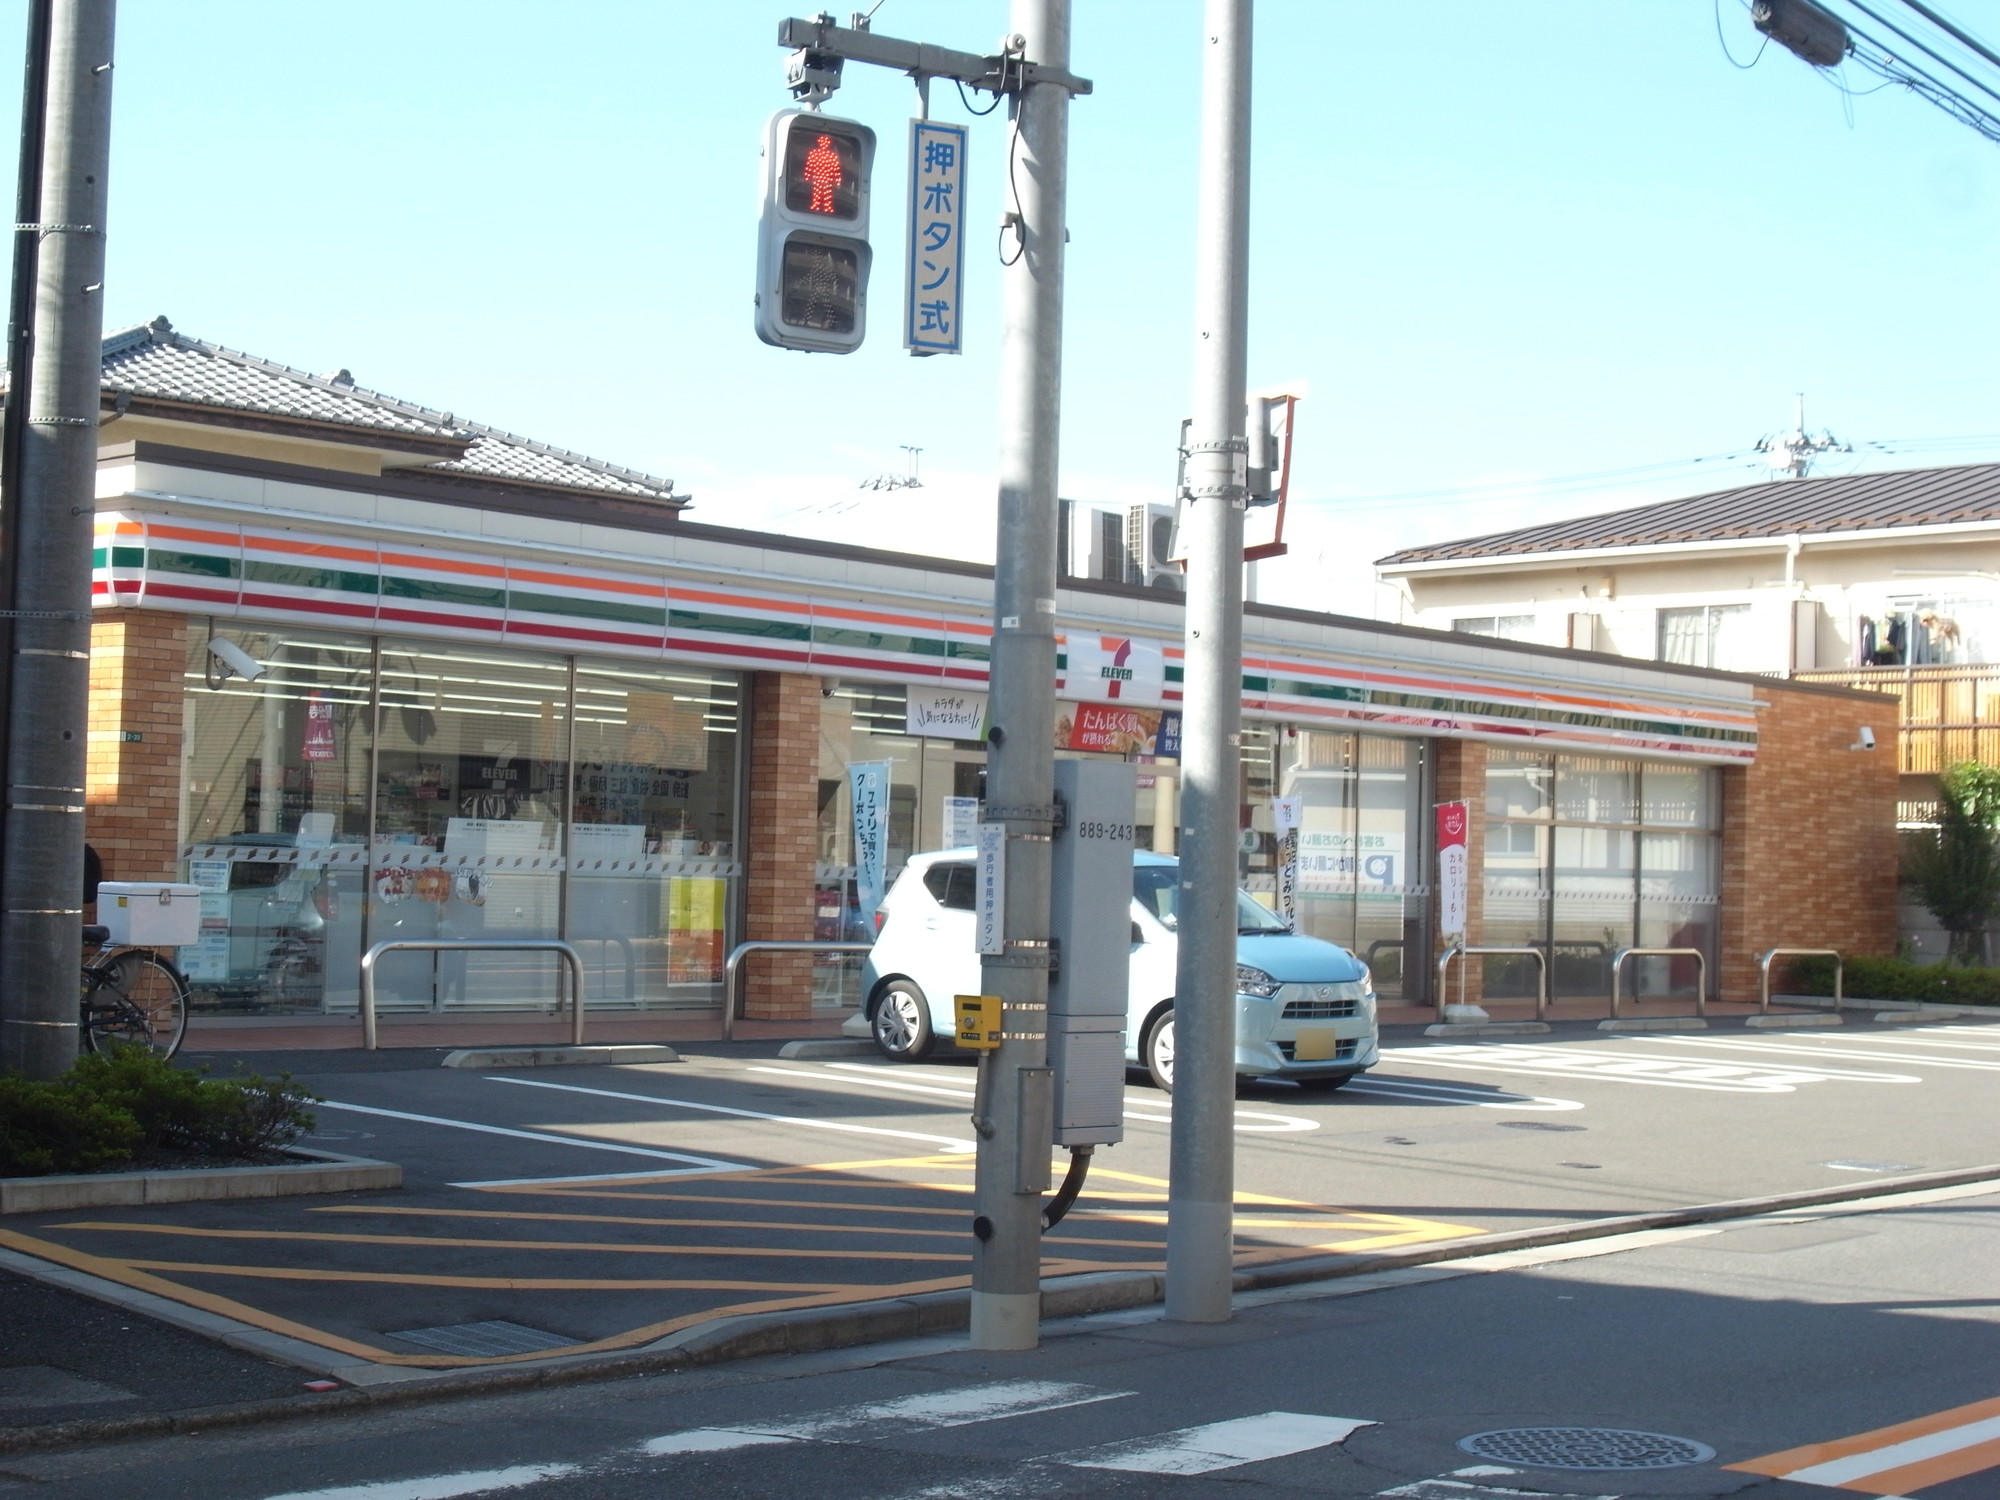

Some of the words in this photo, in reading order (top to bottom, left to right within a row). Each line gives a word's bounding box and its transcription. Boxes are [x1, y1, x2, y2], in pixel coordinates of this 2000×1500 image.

[919, 140, 955, 334] 押ボタン式
[934, 696, 964, 710] カラダが
[1083, 710, 1139, 733] たんぱく質
[1165, 717, 1183, 738] 糖
[1082, 732, 1111, 745] が摂れる
[1165, 738, 1182, 751] 控え
[1079, 821, 1133, 841] 889-243
[985, 853, 994, 946] 歩行者用押ボタン
[1449, 854, 1457, 925] カロリーも!
